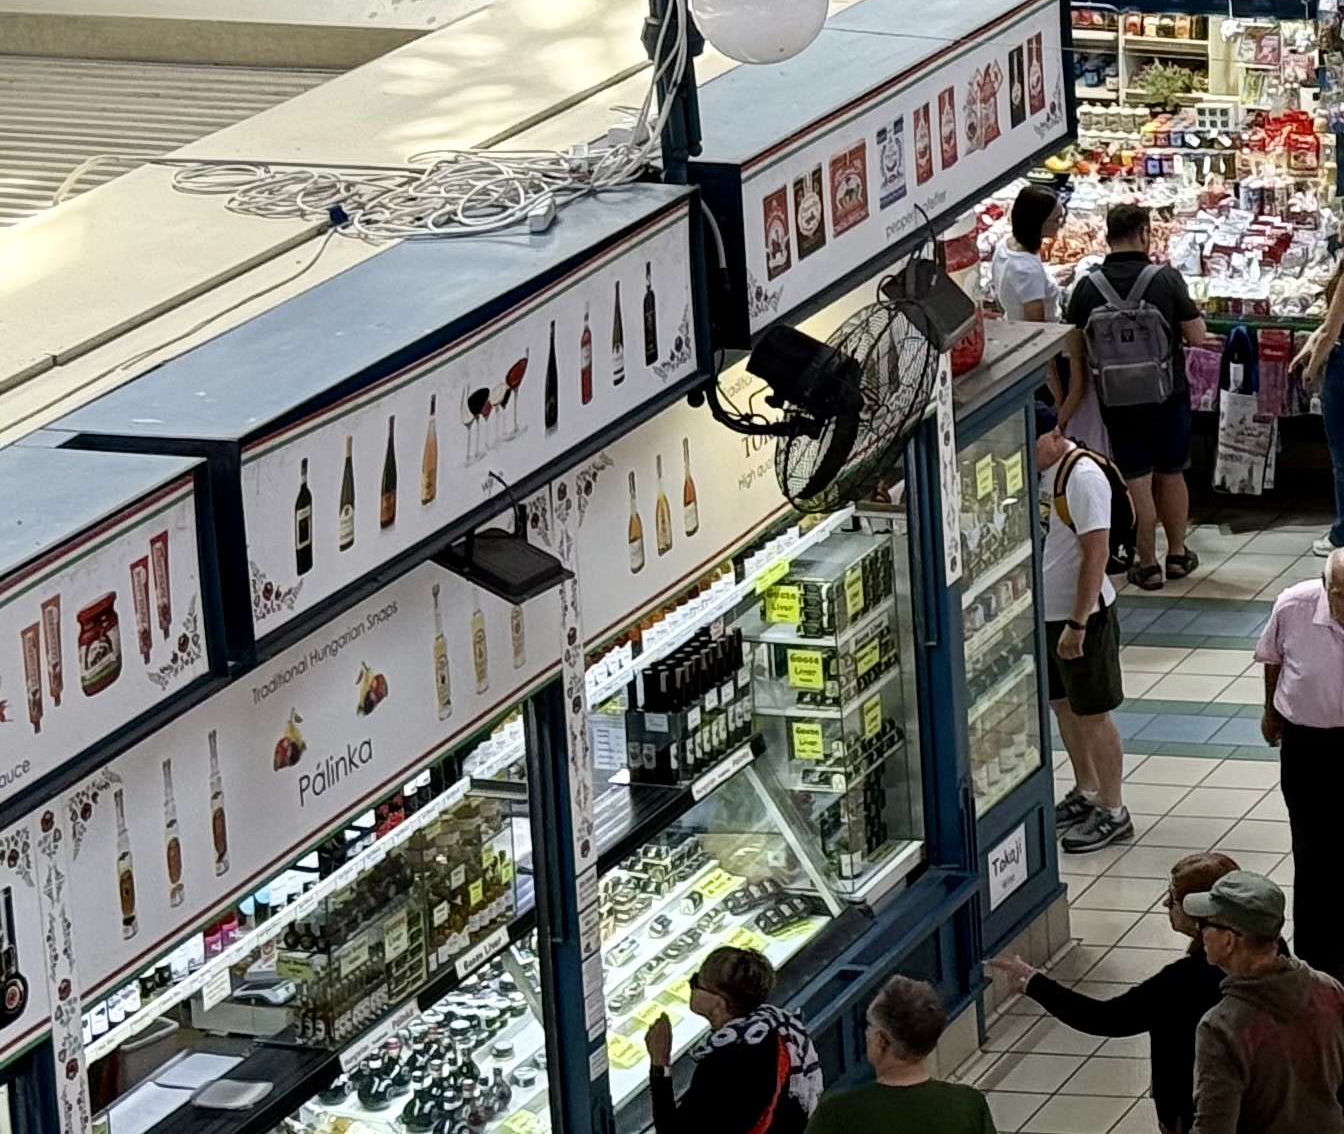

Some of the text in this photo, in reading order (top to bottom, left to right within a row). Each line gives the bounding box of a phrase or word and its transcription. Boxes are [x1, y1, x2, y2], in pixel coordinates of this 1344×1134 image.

[252, 656, 308, 704] Traditional
[309, 622, 365, 667] Hungarian
[298, 737, 374, 808] Pálinka
[991, 836, 1023, 877] Tokaji
